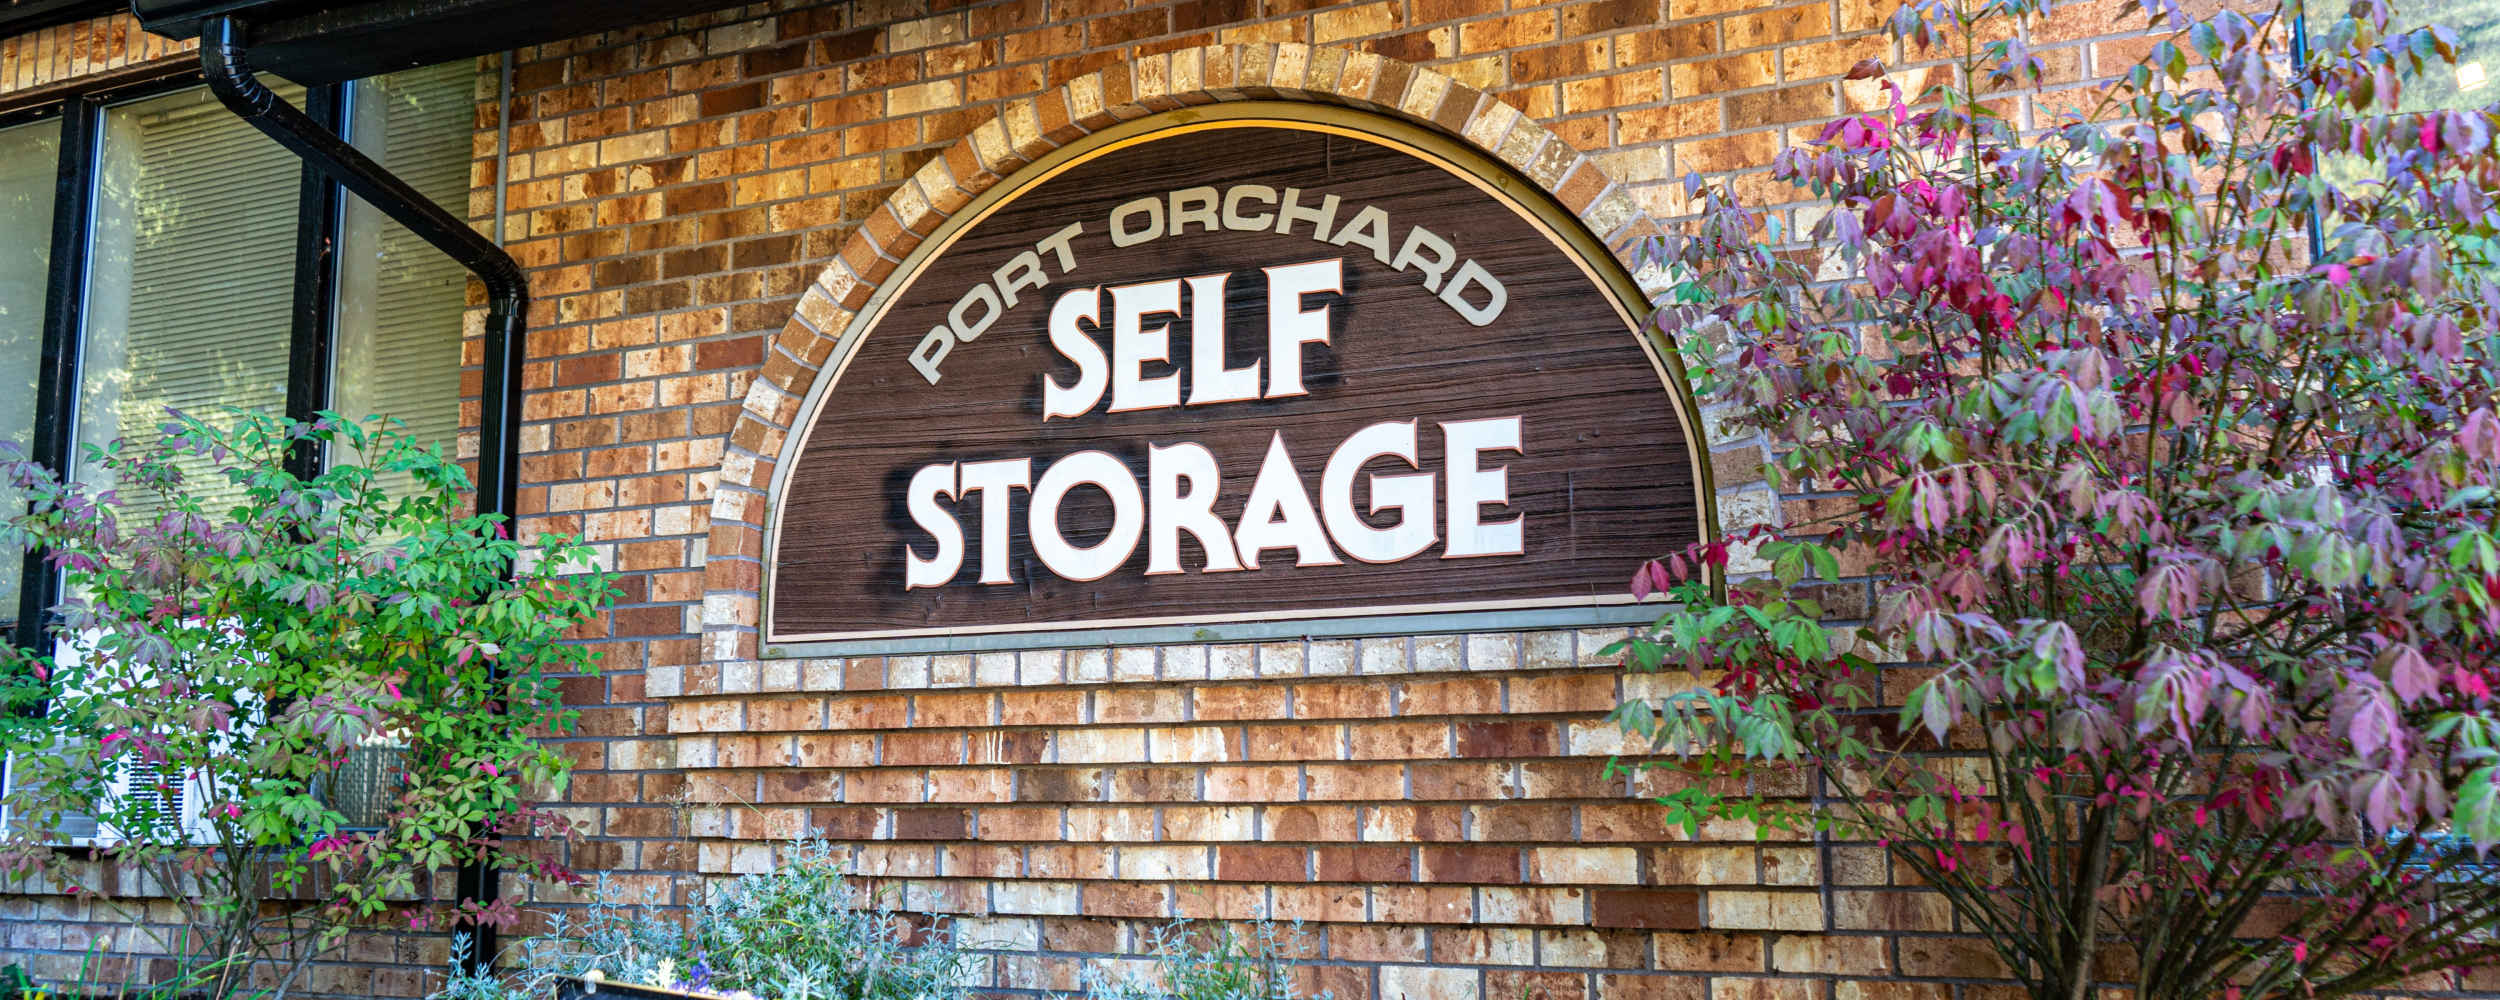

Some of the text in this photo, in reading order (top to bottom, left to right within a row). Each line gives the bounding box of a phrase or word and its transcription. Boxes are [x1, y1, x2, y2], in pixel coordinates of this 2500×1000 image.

[908, 184, 1508, 386] PORT ORCHARD
[1043, 257, 1344, 423] SELF
[905, 415, 1525, 591] STORAGE
